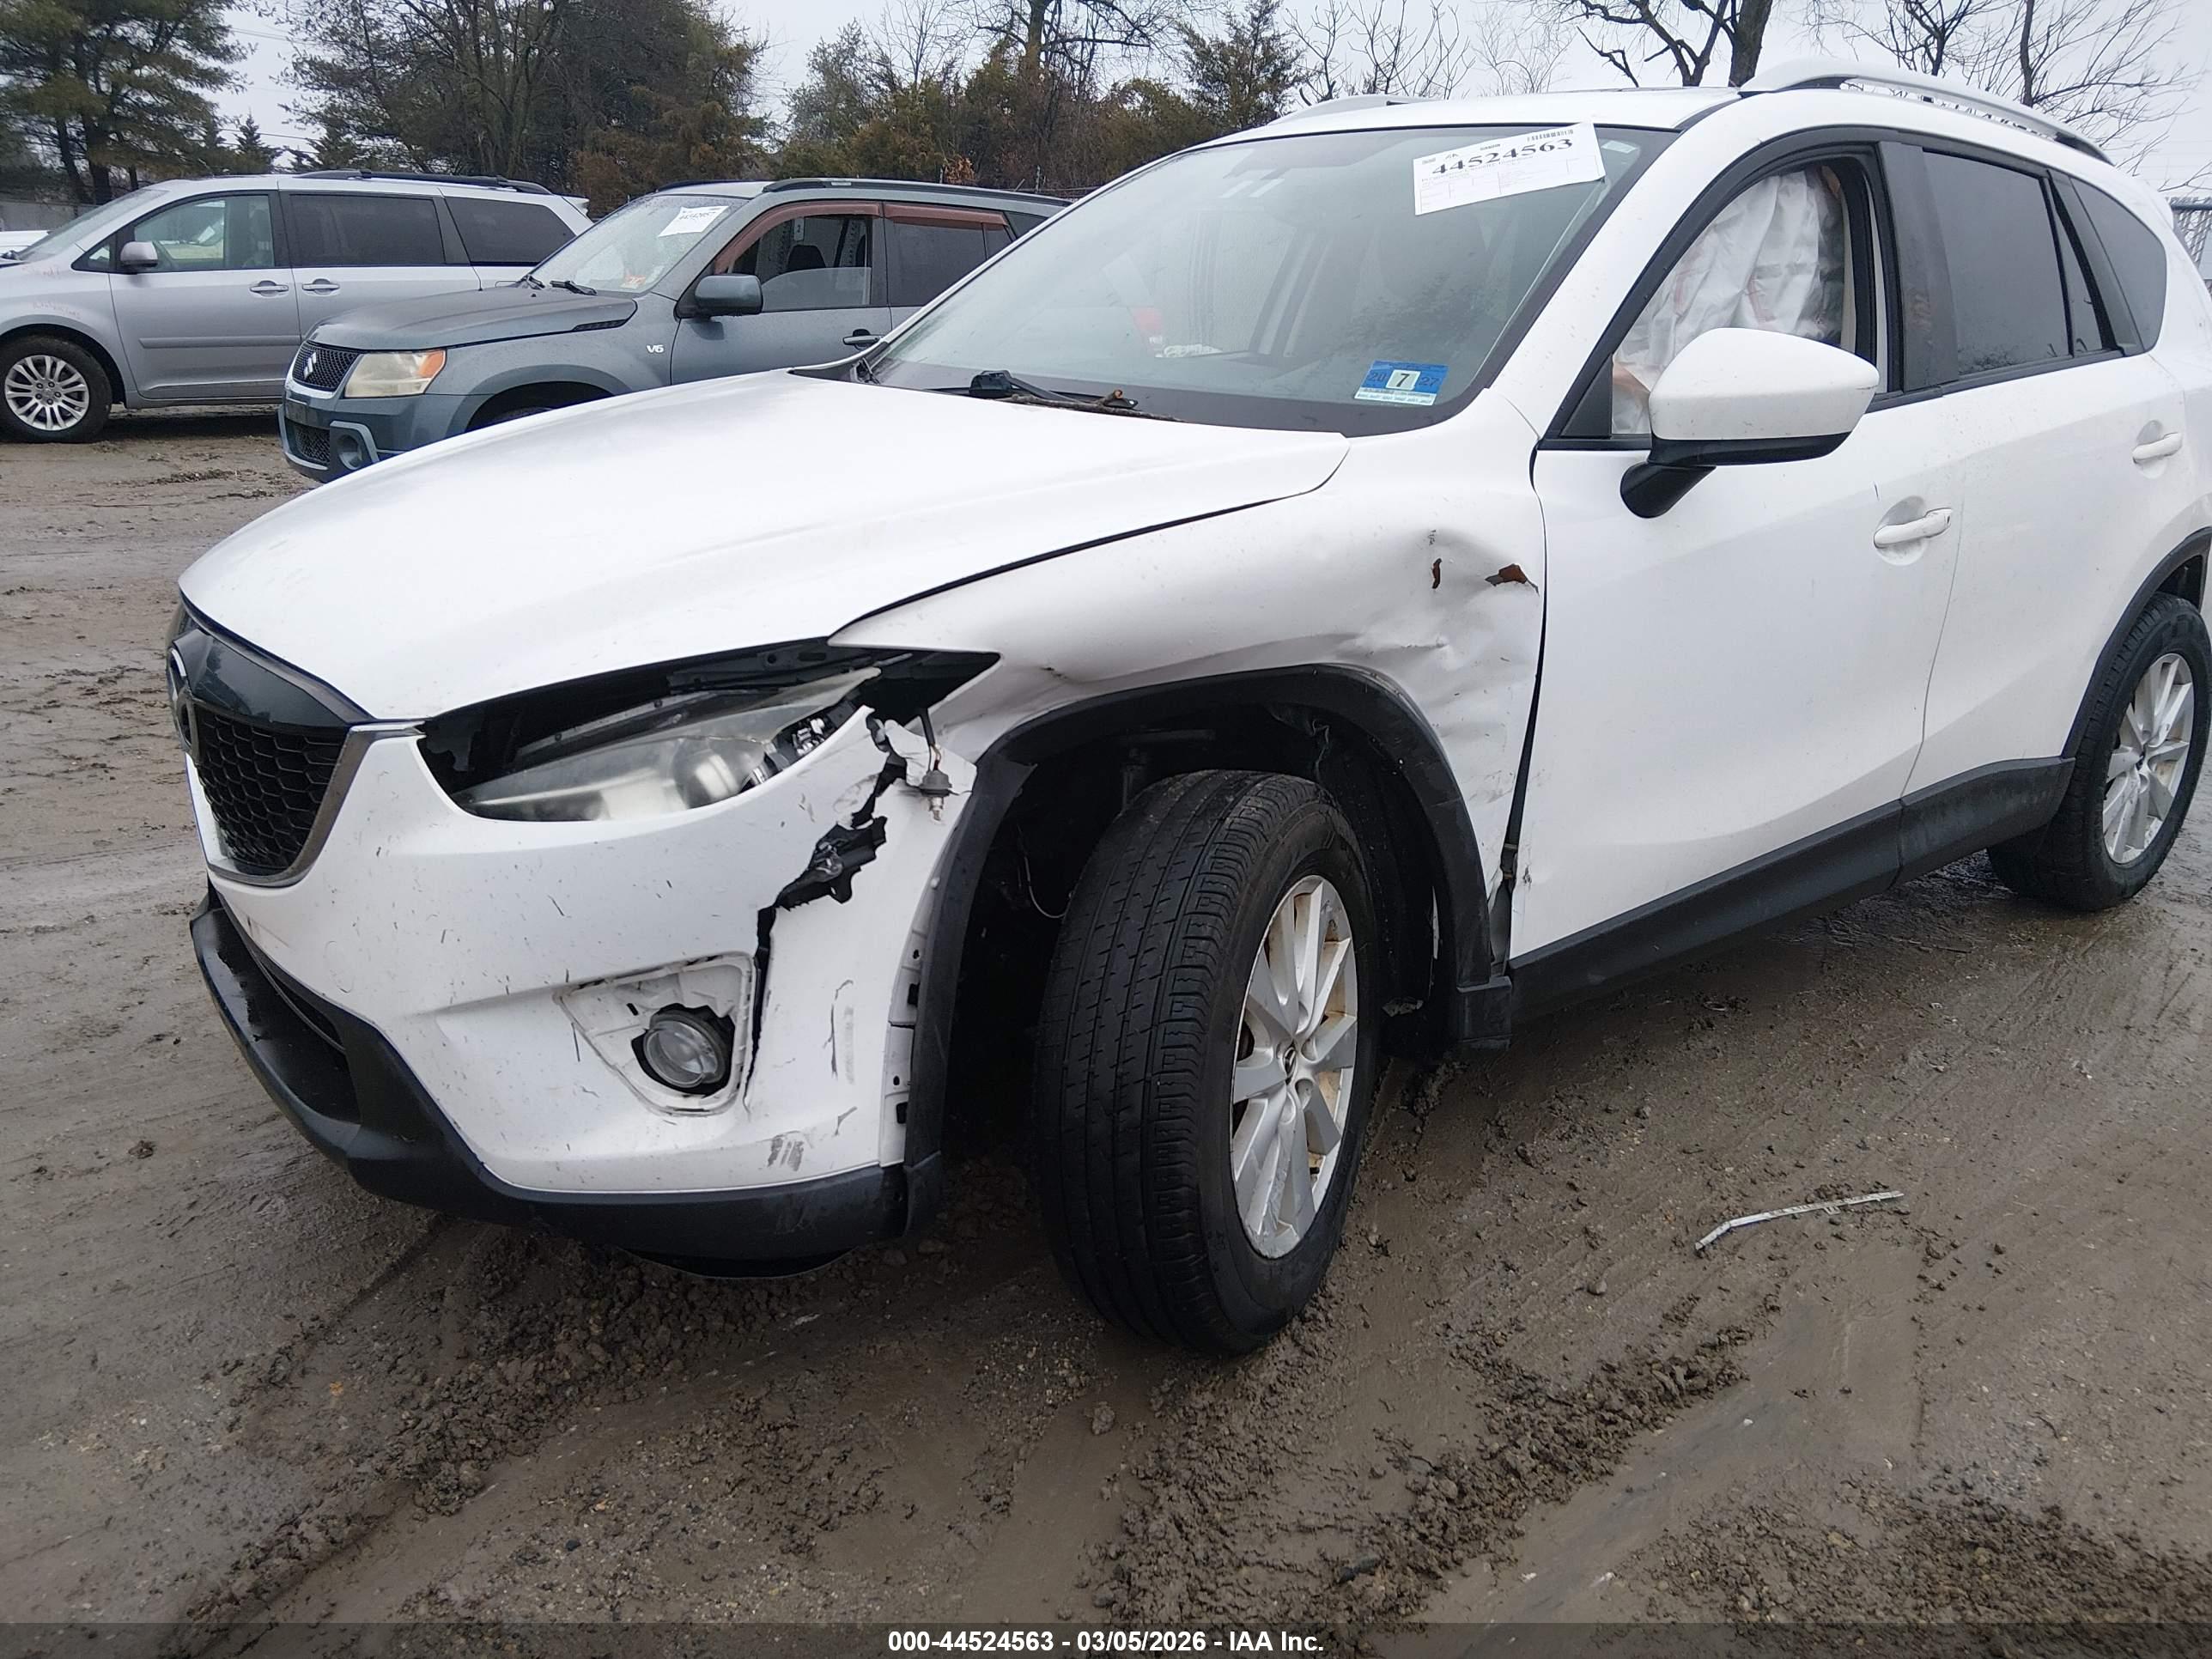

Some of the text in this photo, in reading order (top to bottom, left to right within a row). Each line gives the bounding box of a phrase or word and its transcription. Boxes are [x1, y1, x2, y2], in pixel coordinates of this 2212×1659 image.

[1431, 138, 1573, 174] 44524563
[646, 344, 665, 353] V6
[1396, 373, 1410, 387] 7
